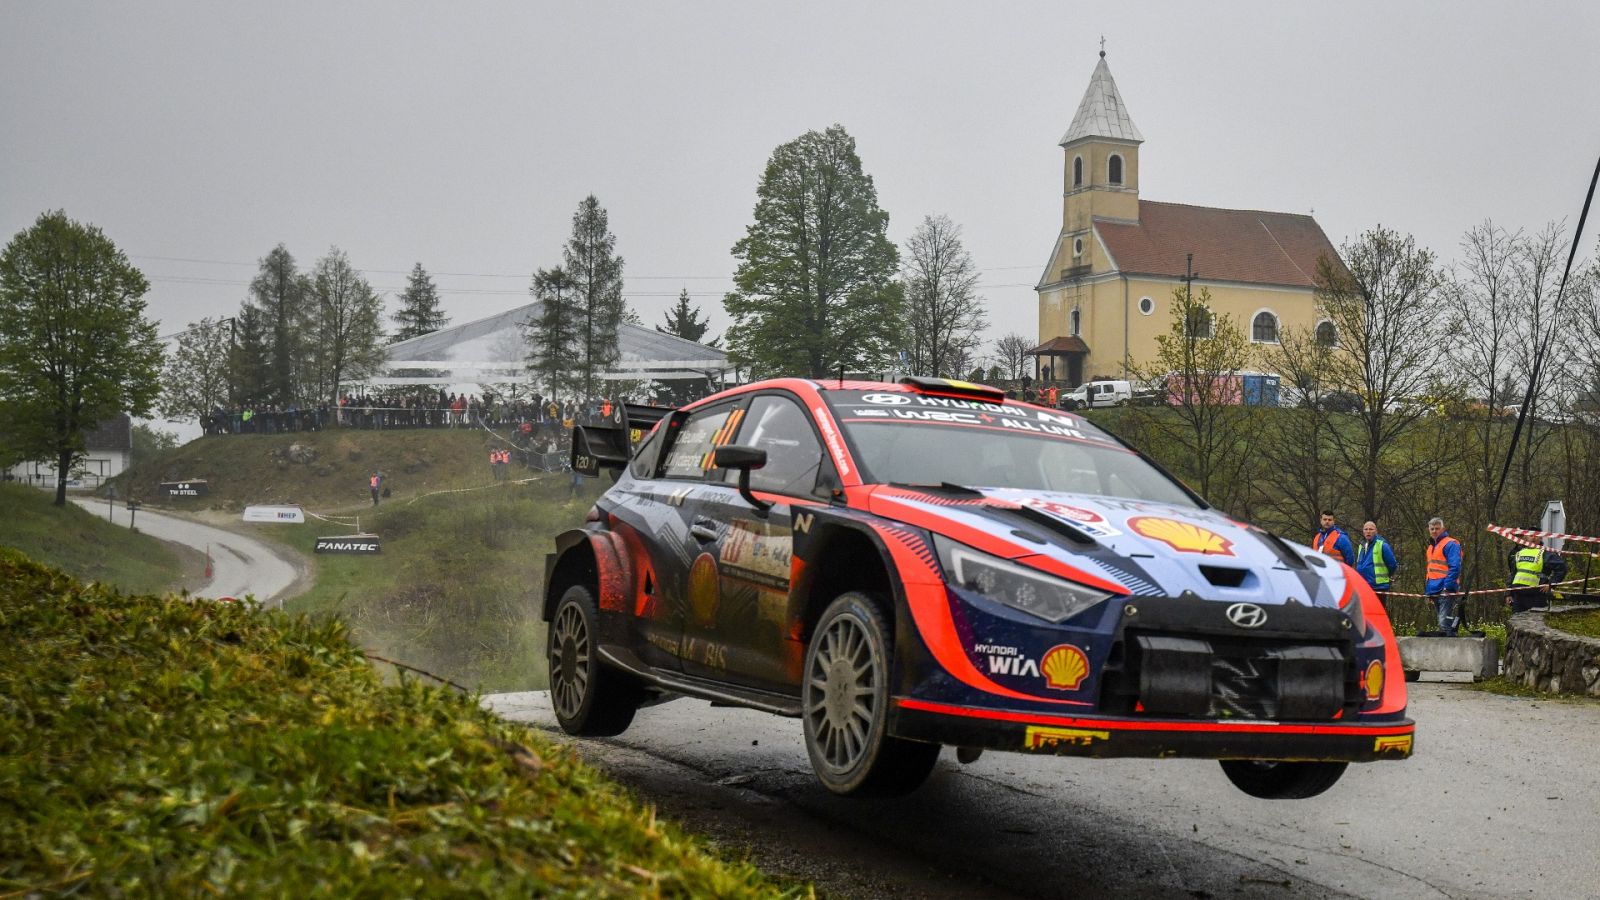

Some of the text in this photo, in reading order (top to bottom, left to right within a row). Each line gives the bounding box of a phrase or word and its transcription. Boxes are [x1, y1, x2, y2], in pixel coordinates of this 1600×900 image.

[915, 395, 1027, 417] HYUNDAI
[1001, 418, 1041, 432] ALL
[1039, 423, 1087, 440] LIVE
[317, 541, 379, 551] FANATEC
[974, 643, 1018, 656] HYUNDAI
[988, 654, 1041, 678] WIA
